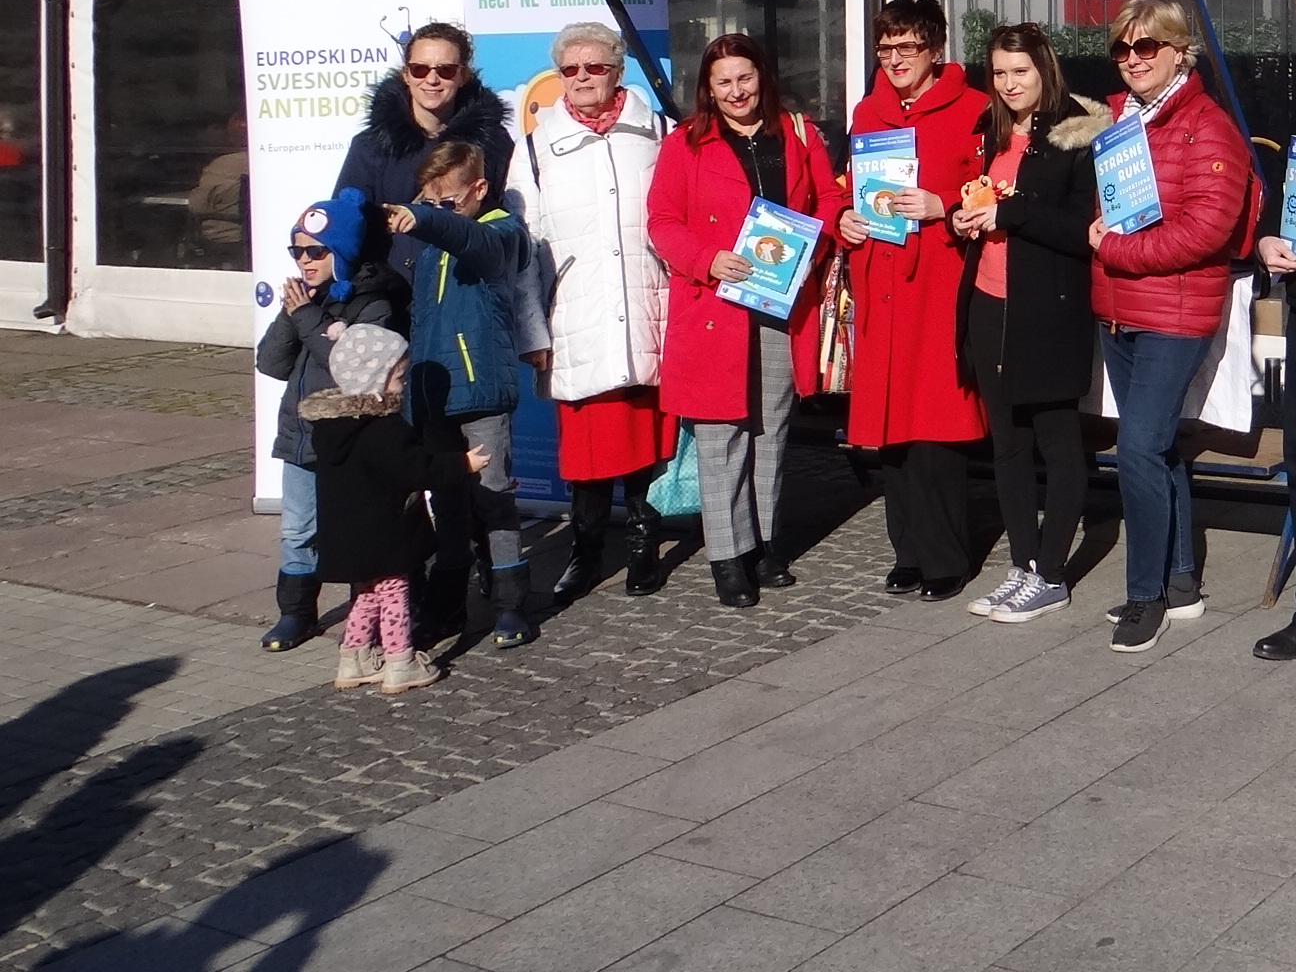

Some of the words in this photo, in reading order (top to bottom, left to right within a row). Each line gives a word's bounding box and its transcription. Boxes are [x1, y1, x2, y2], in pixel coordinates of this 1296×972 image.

[256, 49, 345, 67] EUROPSKI
[351, 48, 388, 64] DAN
[257, 70, 378, 91] SVJESNOSTI
[259, 144, 265, 152] A
[268, 143, 310, 154] European
[314, 142, 344, 151] Health
[857, 158, 887, 174] STRA
[1098, 141, 1143, 177] STRAŠNE
[1118, 158, 1147, 183] RUKE
